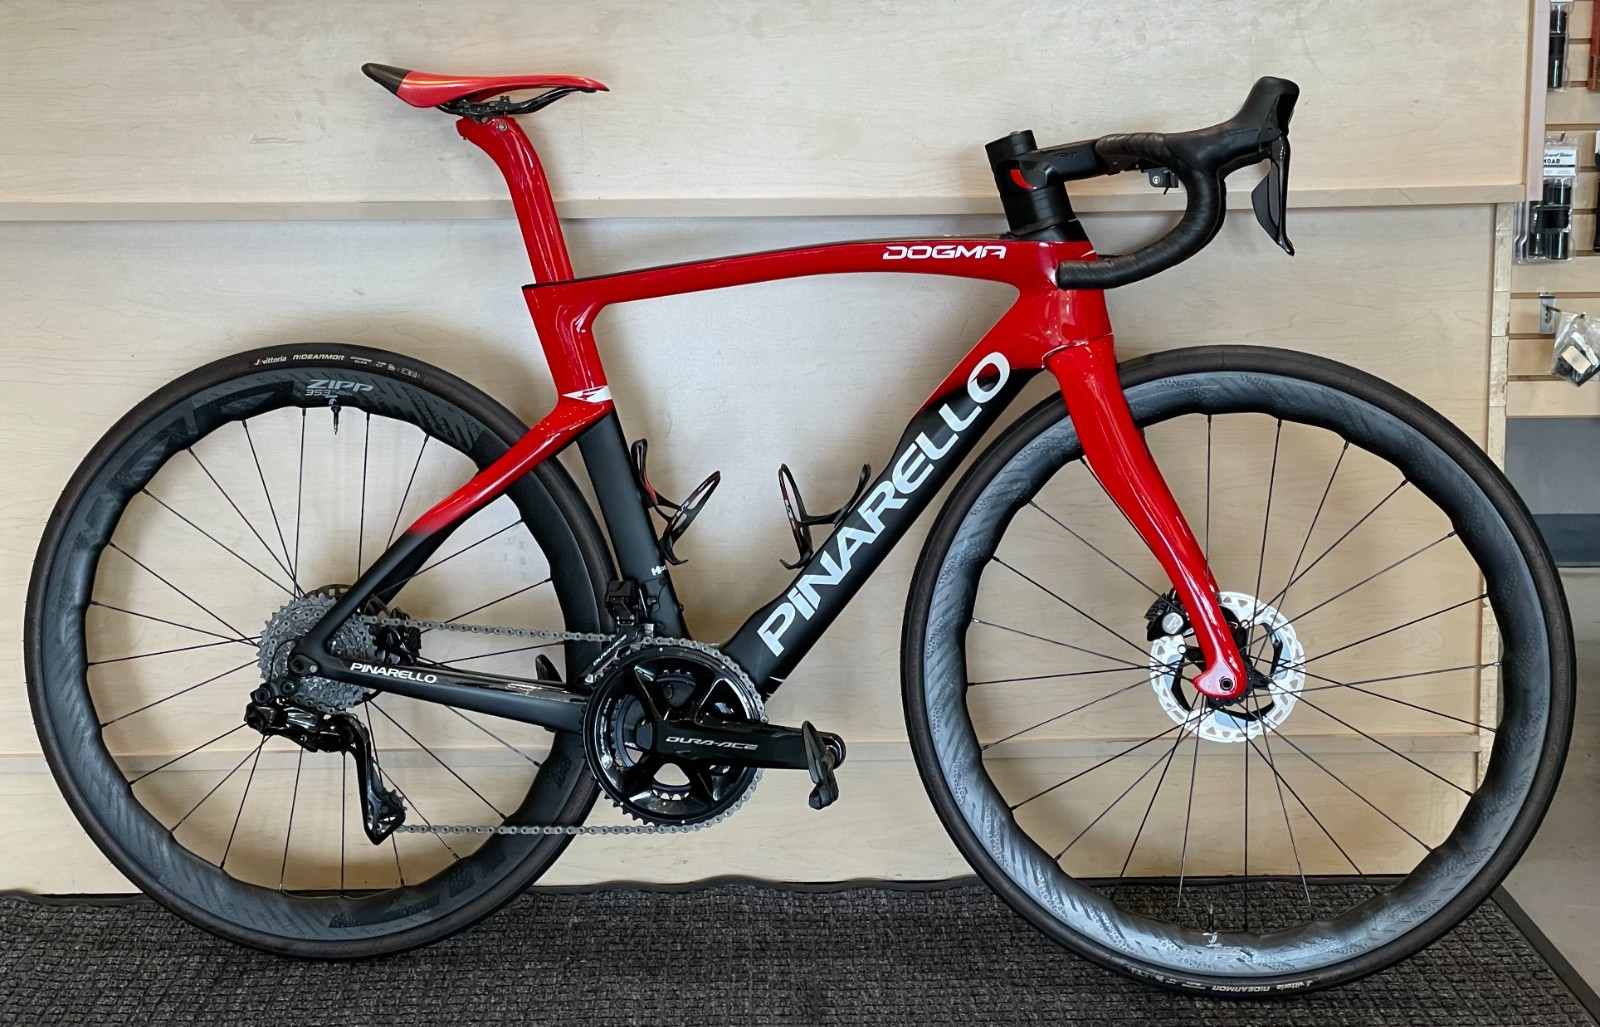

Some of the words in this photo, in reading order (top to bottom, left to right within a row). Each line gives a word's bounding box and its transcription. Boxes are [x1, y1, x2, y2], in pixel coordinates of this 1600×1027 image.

[882, 245, 1007, 260] DOGMA
[292, 353, 345, 361] RIDEARMOR
[306, 379, 374, 392] ZIPP
[757, 352, 1011, 657] PINARELLO
[349, 662, 437, 684] PINARELLO
[665, 736, 759, 751] DURA-ACE
